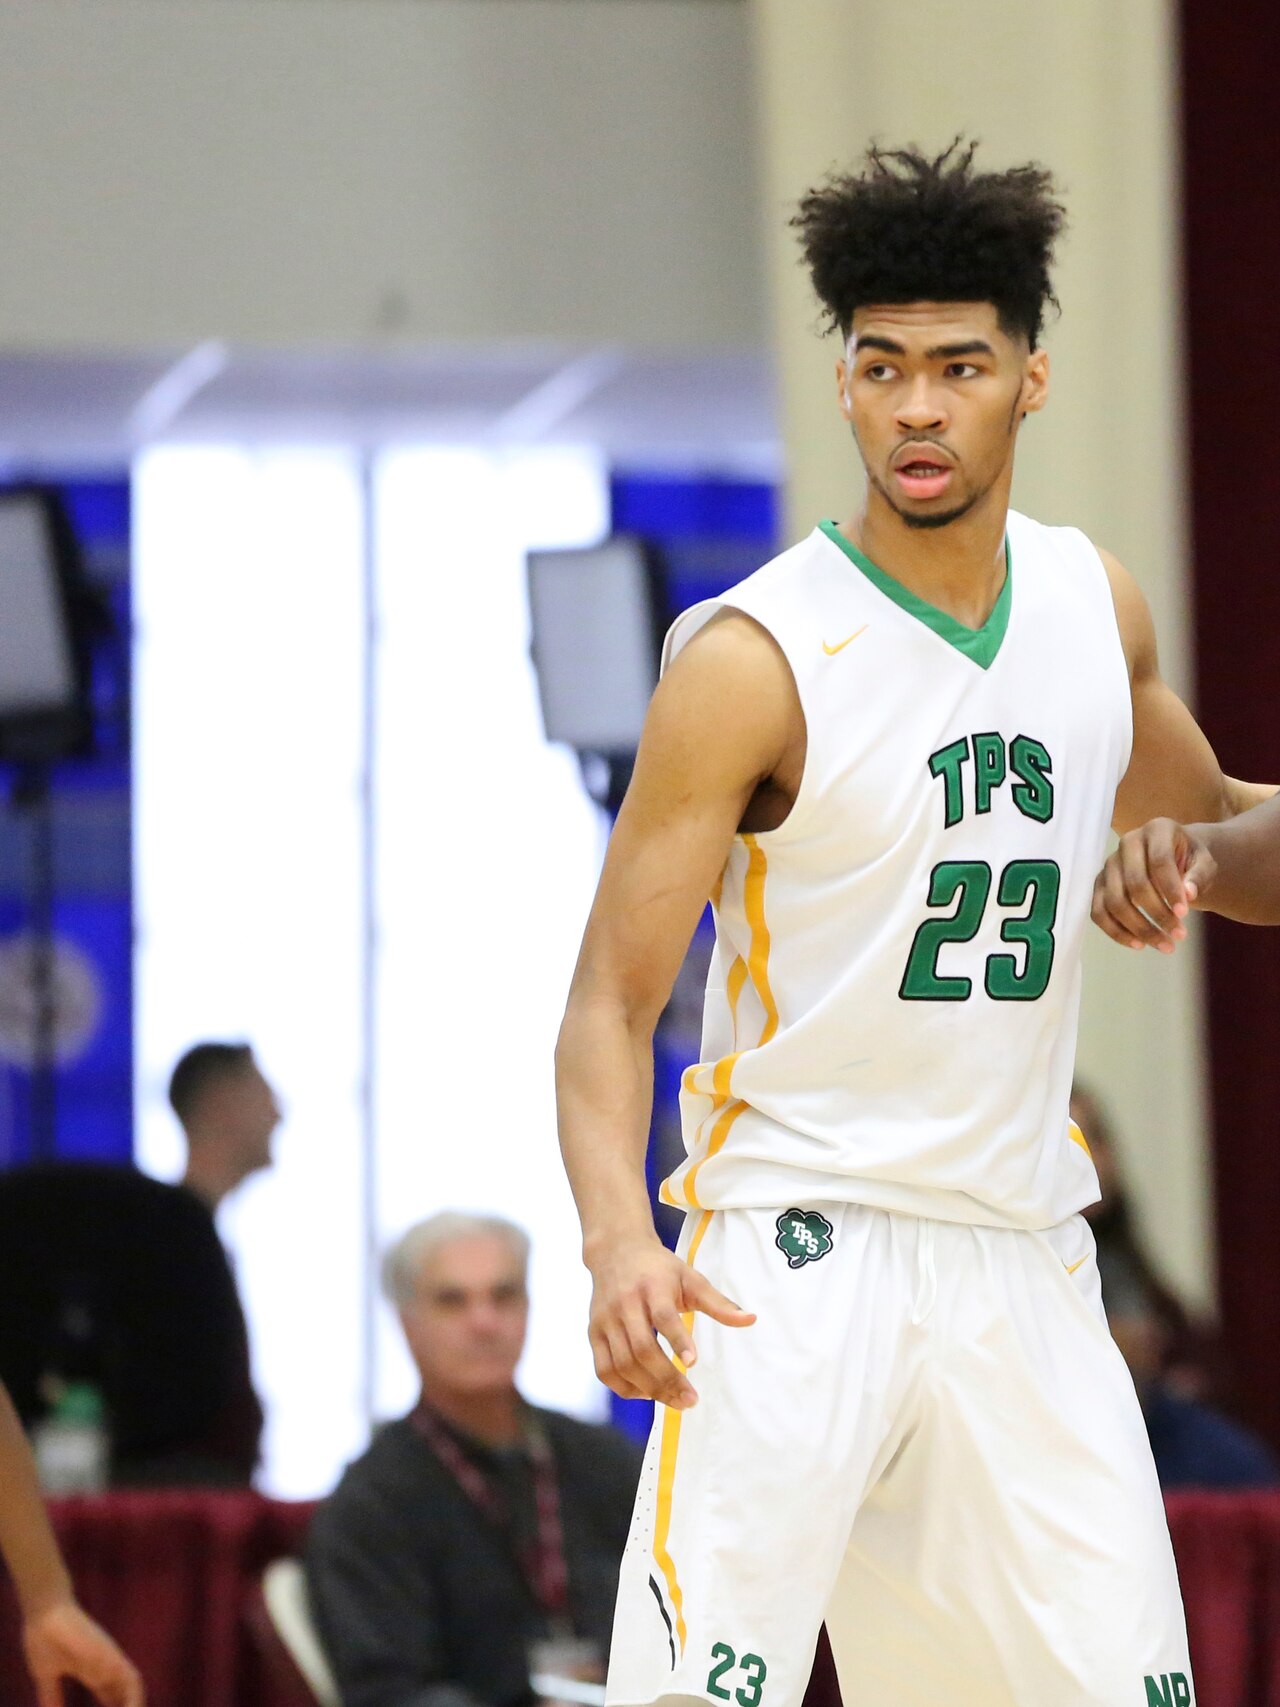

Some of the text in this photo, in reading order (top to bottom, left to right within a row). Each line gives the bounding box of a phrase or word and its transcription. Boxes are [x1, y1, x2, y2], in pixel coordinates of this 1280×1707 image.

[928, 731, 1054, 830] TPS
[898, 859, 1061, 1002] 23
[791, 1220, 820, 1255] TPS
[706, 1641, 767, 1707] 23
